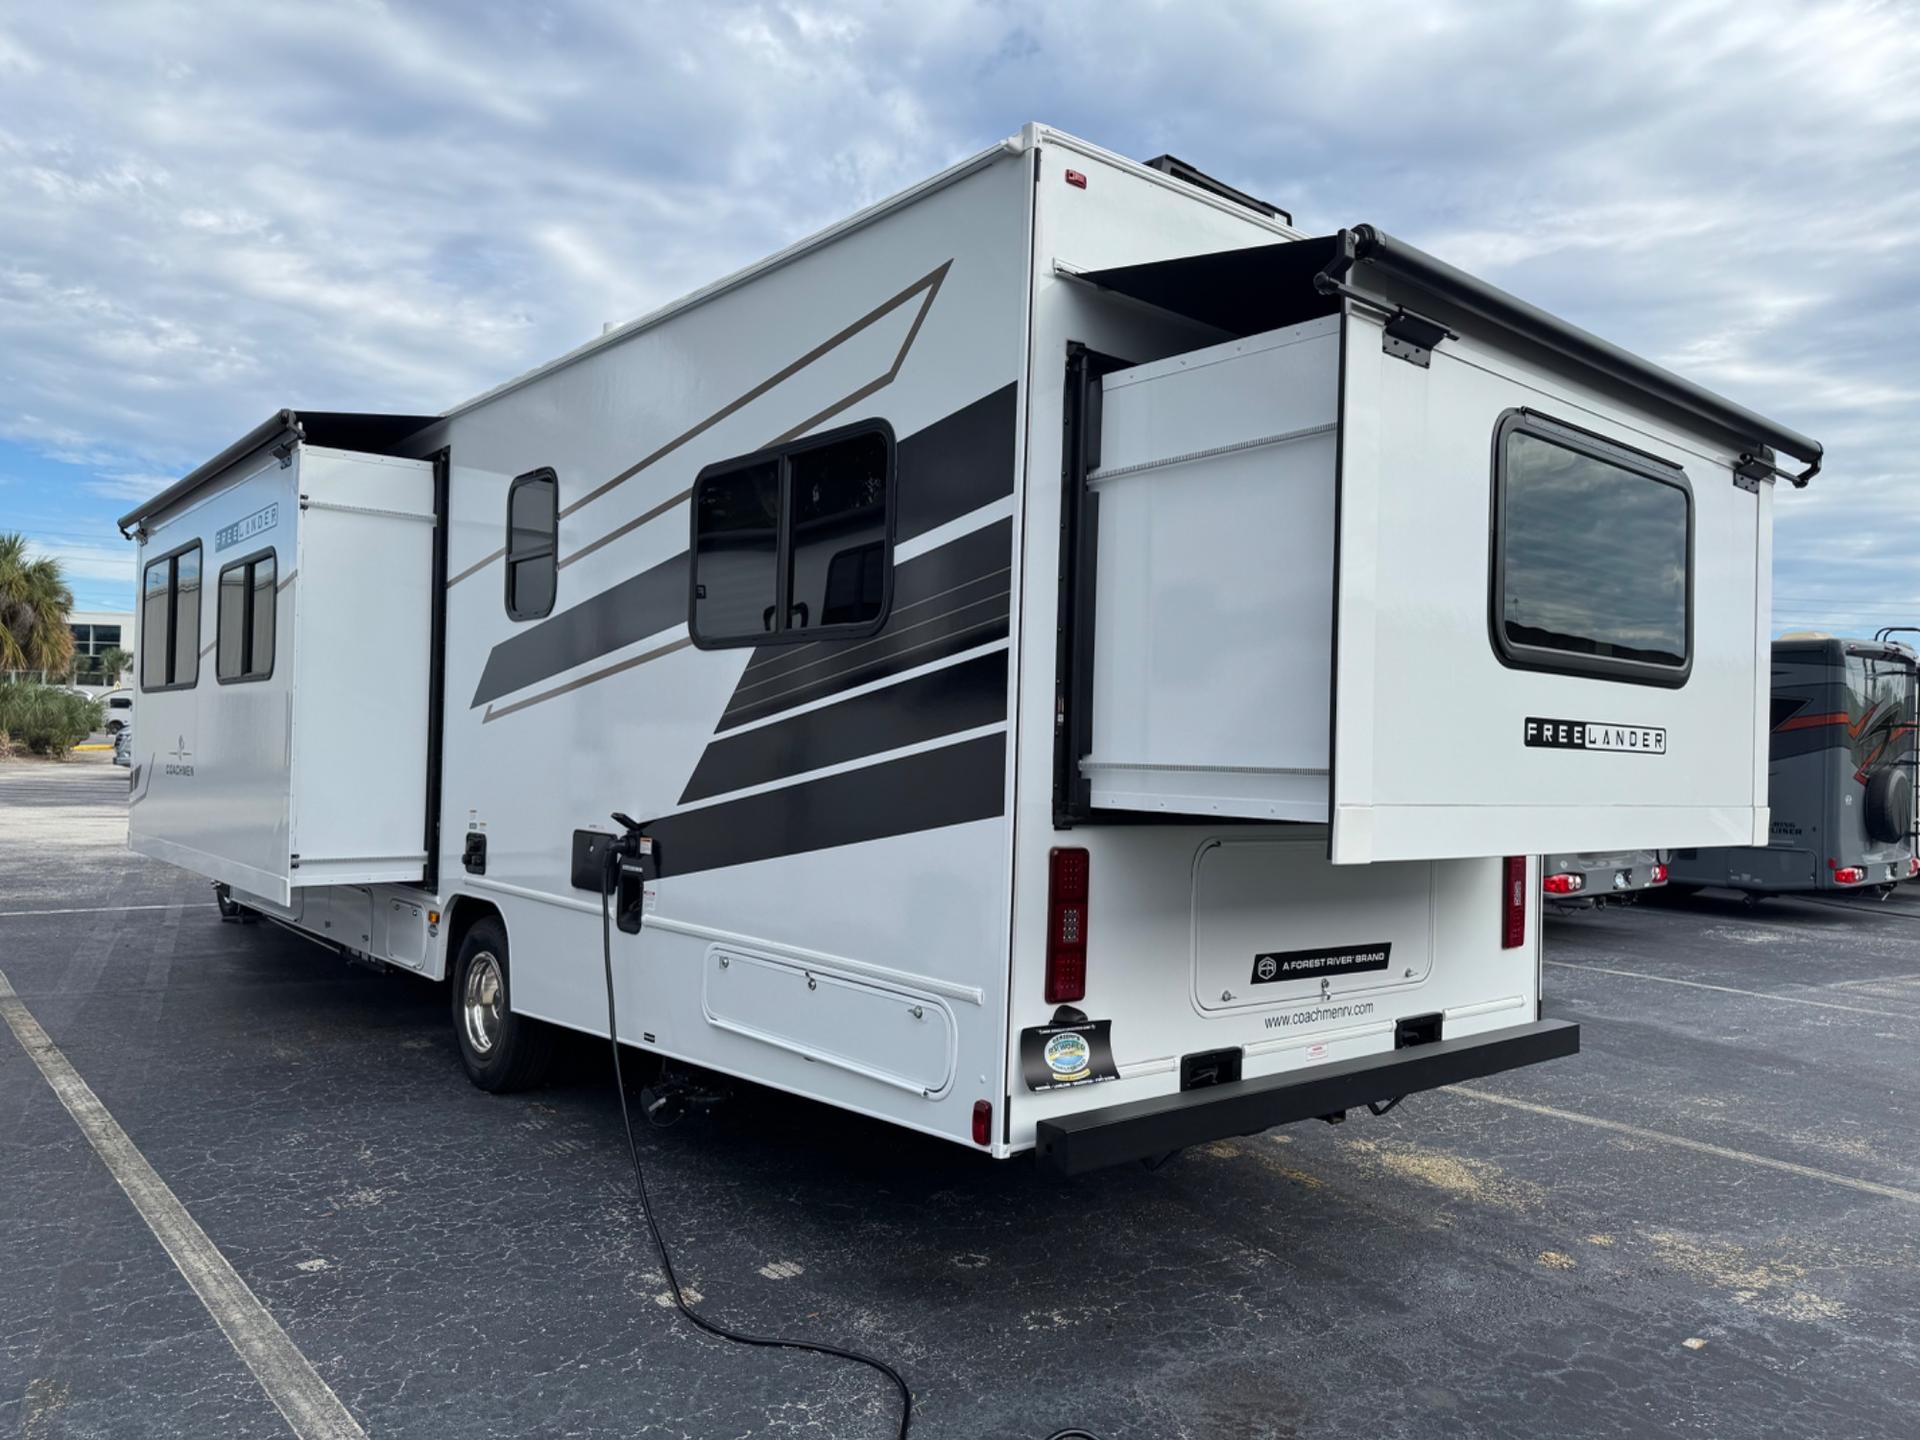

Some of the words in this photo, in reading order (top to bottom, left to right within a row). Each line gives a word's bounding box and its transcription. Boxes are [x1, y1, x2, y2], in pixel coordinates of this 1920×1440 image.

[216, 507, 277, 544] FREELANDER
[1527, 723, 1663, 749] FREELANDER
[166, 764, 195, 777] COACHMEN
[1282, 961, 1290, 971] A
[1291, 958, 1325, 970] FOREST
[1327, 955, 1352, 966] RIVER
[1355, 952, 1385, 963] BRAND
[1264, 1002, 1374, 1029] www.coachmenrv.com
